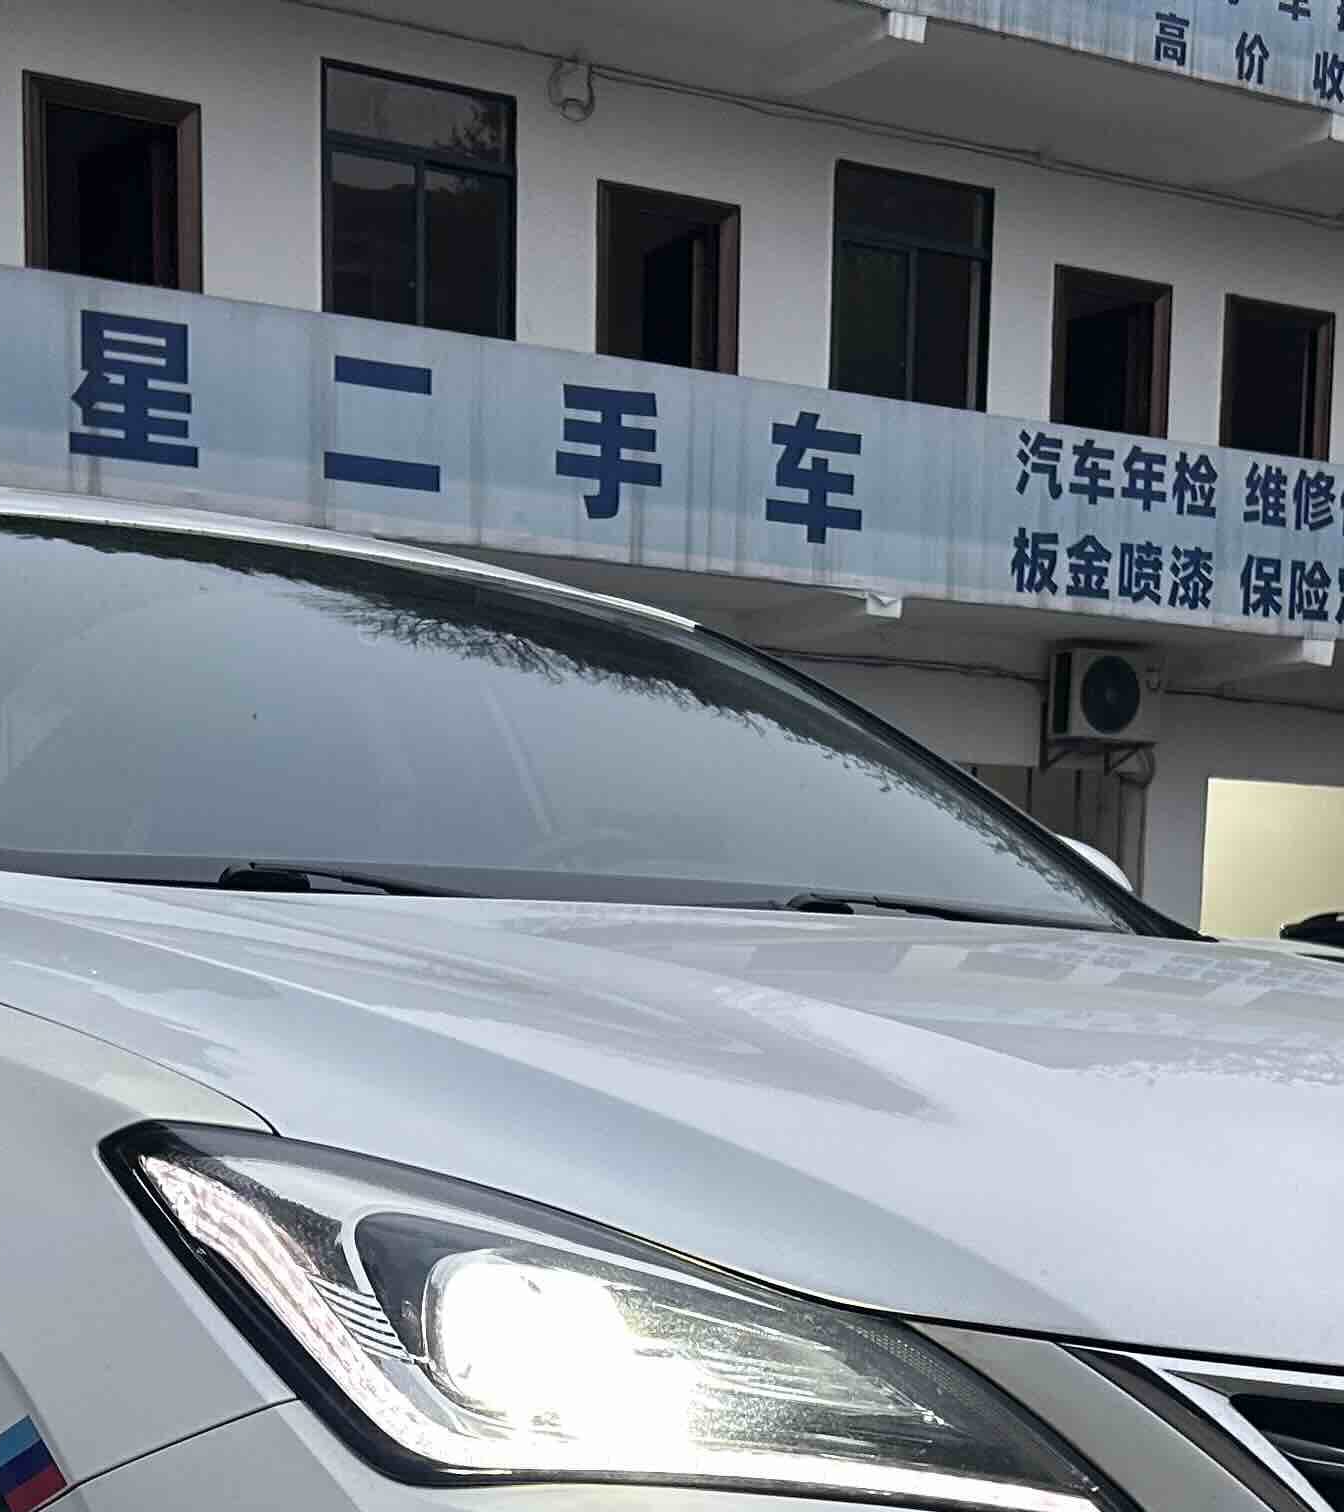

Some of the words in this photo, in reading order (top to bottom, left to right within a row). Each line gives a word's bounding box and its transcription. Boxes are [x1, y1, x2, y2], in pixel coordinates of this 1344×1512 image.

[1016, 430, 1219, 518] 汽车年检
[1011, 527, 1214, 610] 板金喷漆
